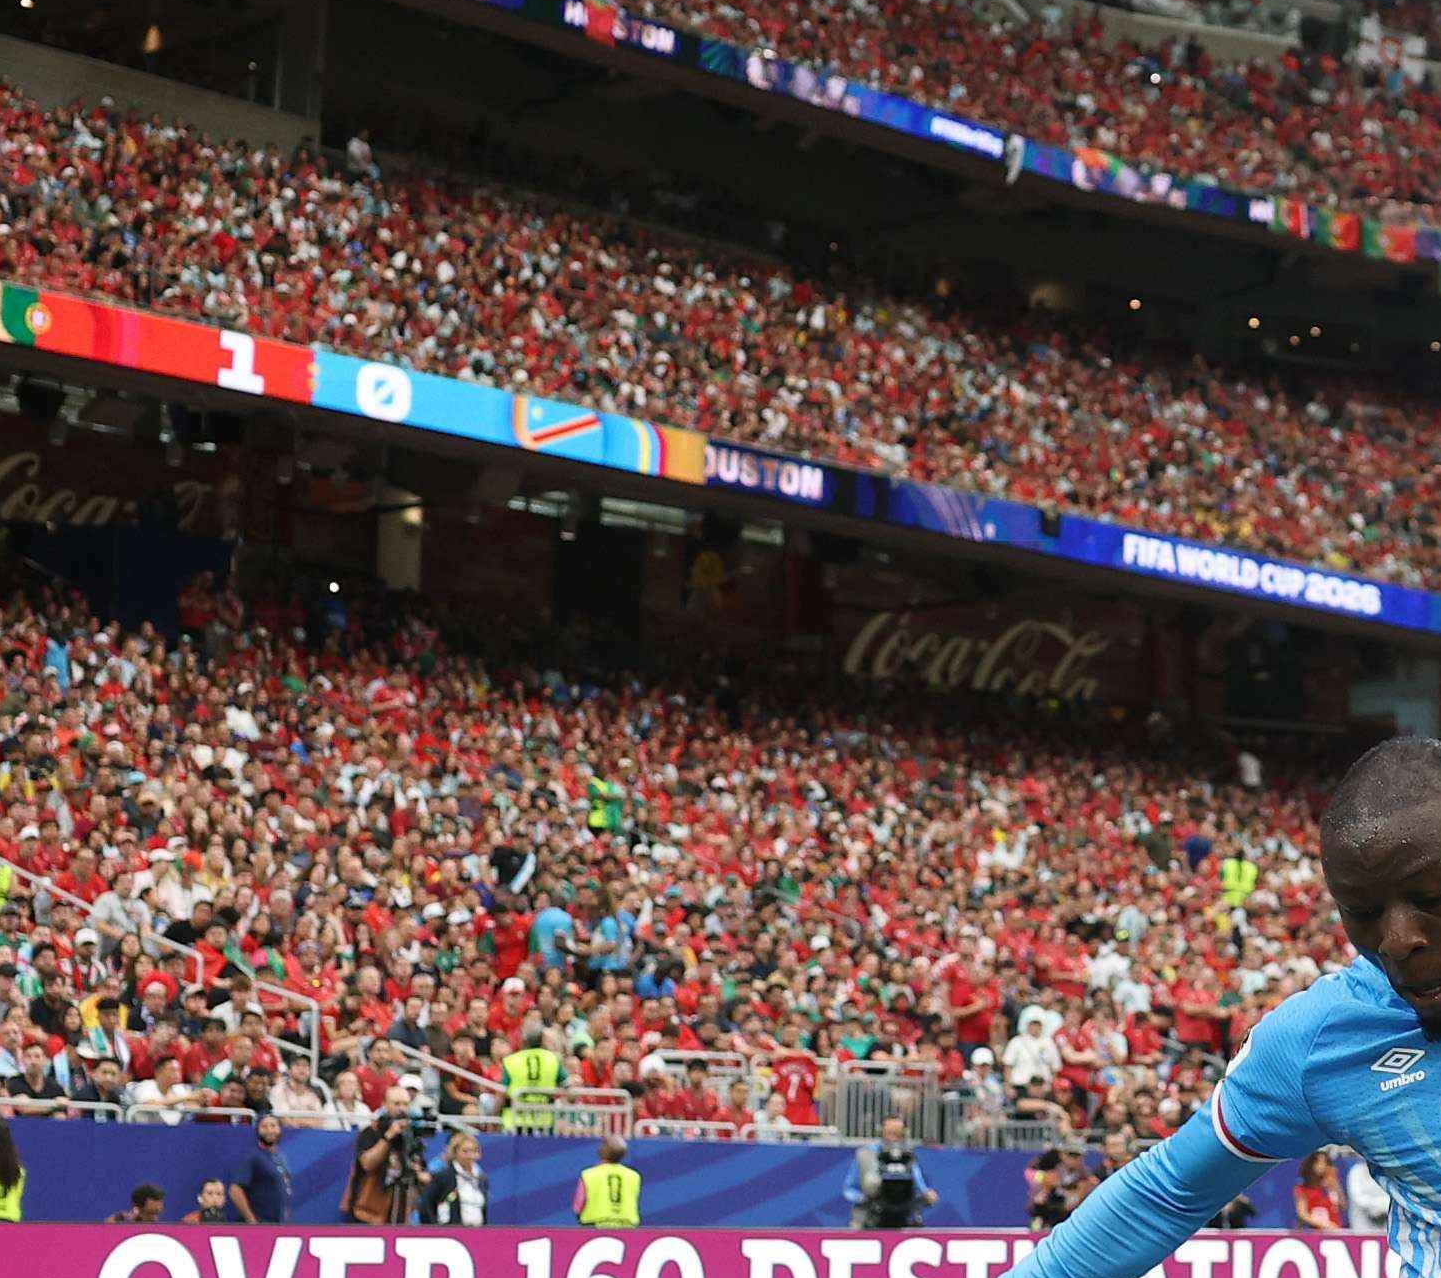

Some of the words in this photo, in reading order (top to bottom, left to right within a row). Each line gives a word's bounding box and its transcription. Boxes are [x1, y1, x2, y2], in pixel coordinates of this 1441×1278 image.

[216, 330, 265, 393] 1
[355, 362, 412, 420] 0
[1123, 532, 1177, 573] FIFA
[1176, 543, 1260, 590] WORLD
[1260, 562, 1305, 598] CUP
[1380, 1068, 1426, 1092] umbro
